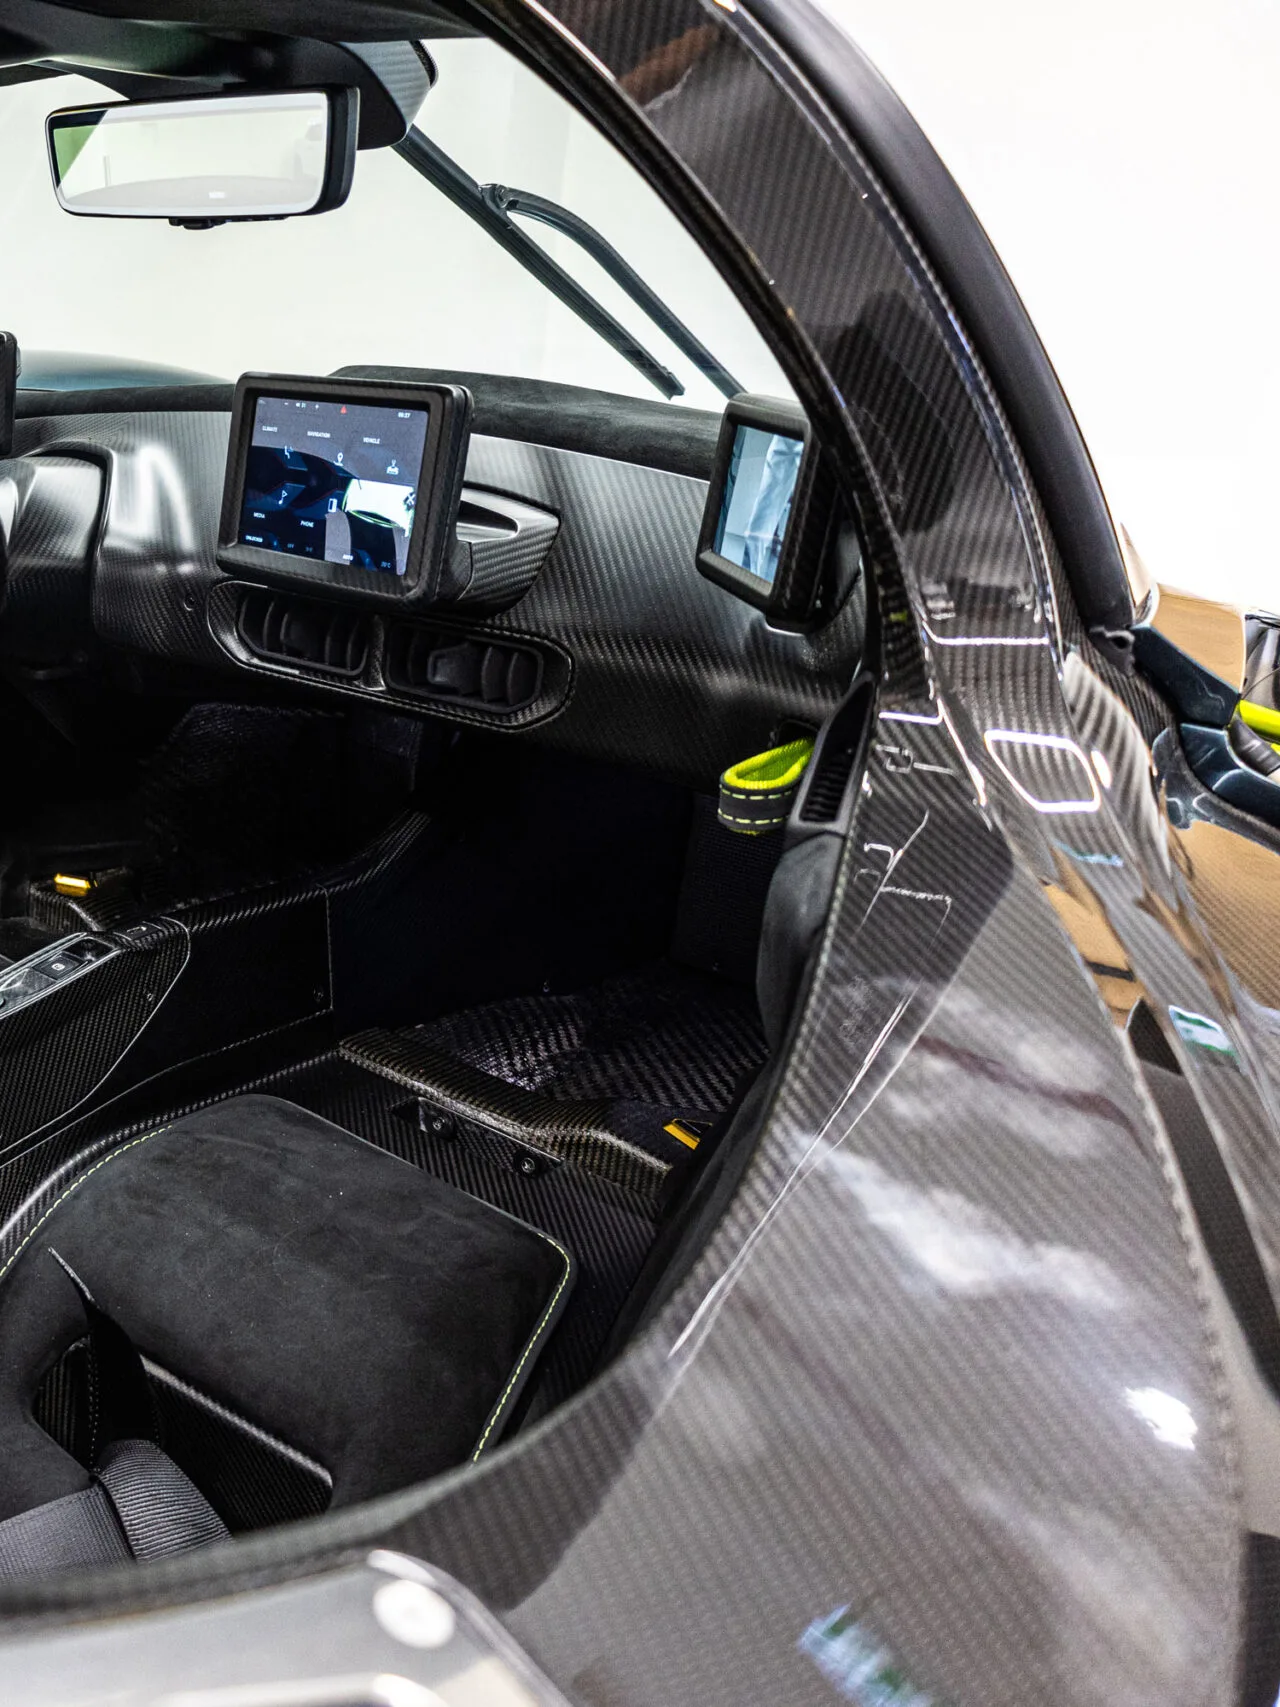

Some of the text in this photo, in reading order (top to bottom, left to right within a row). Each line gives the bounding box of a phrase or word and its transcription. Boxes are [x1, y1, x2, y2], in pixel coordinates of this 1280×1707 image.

[307, 431, 331, 439] NAVIGATION
[363, 437, 381, 445] VEHICLE
[253, 511, 266, 519] MEDIA
[300, 520, 314, 528] PHONE
